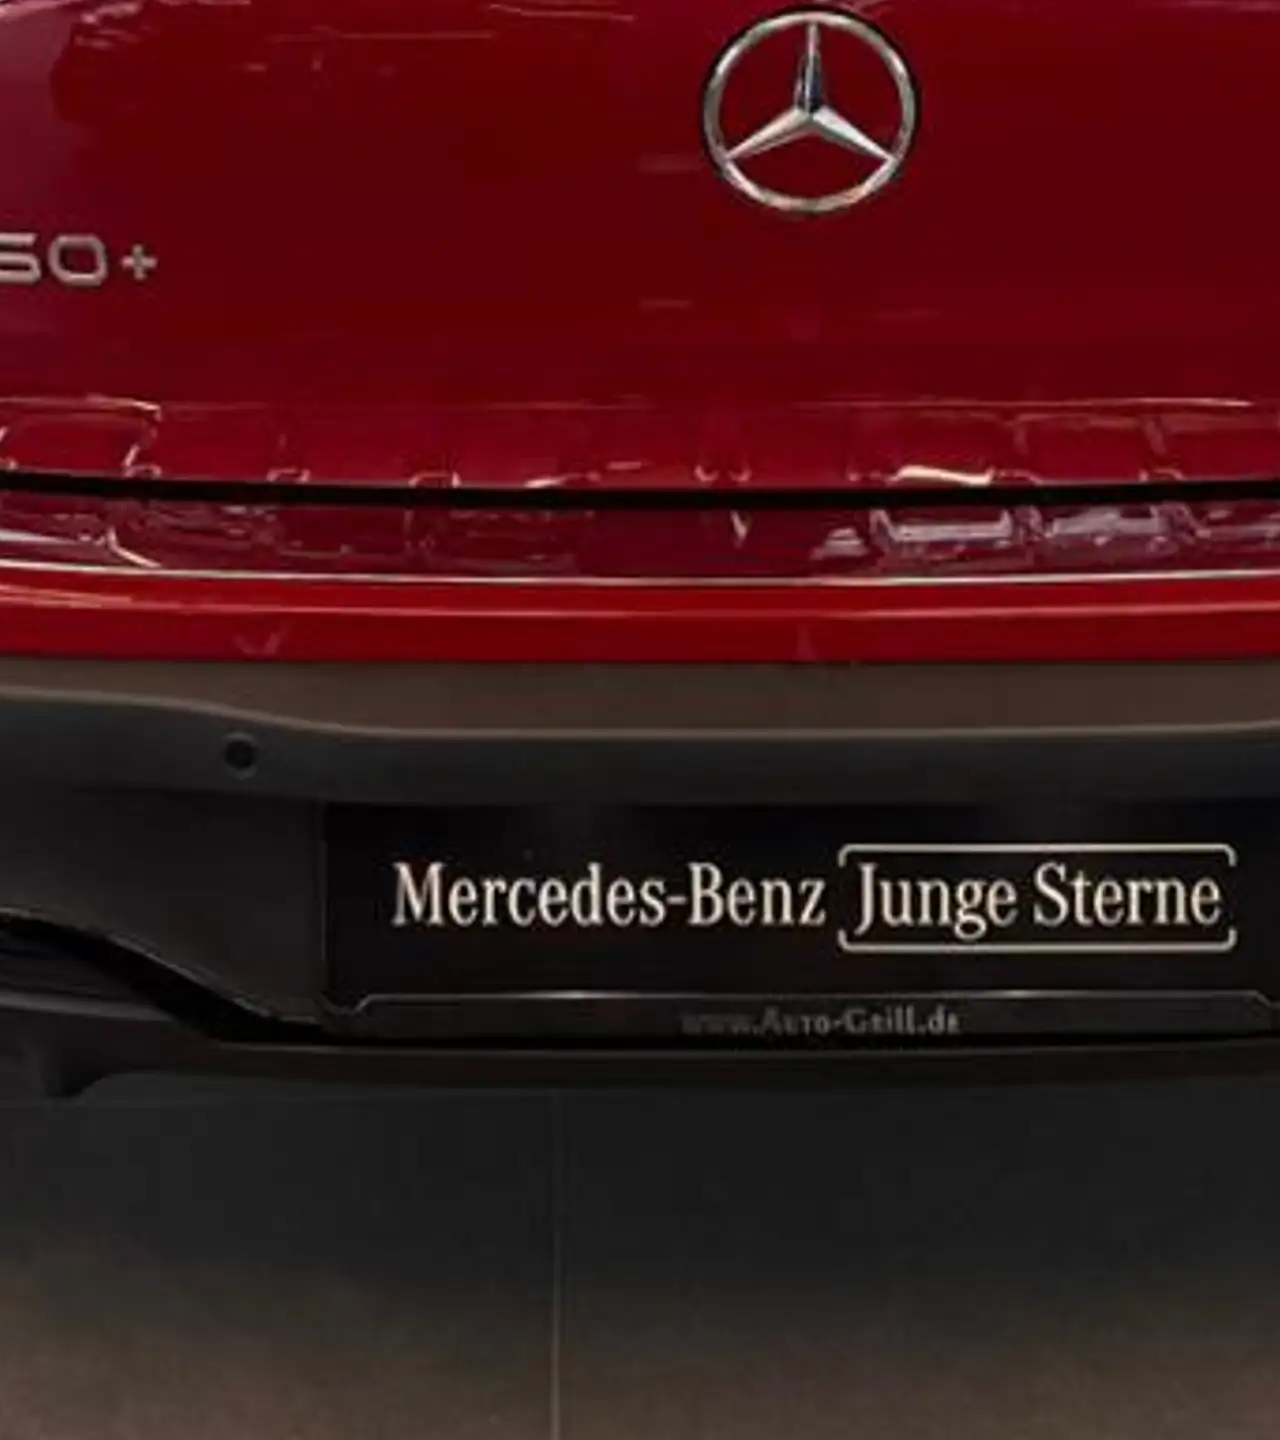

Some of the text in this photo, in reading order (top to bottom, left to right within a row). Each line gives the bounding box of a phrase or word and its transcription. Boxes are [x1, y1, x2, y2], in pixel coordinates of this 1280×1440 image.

[391, 860, 1221, 940] Mercedes-Benz Junge Sterne
